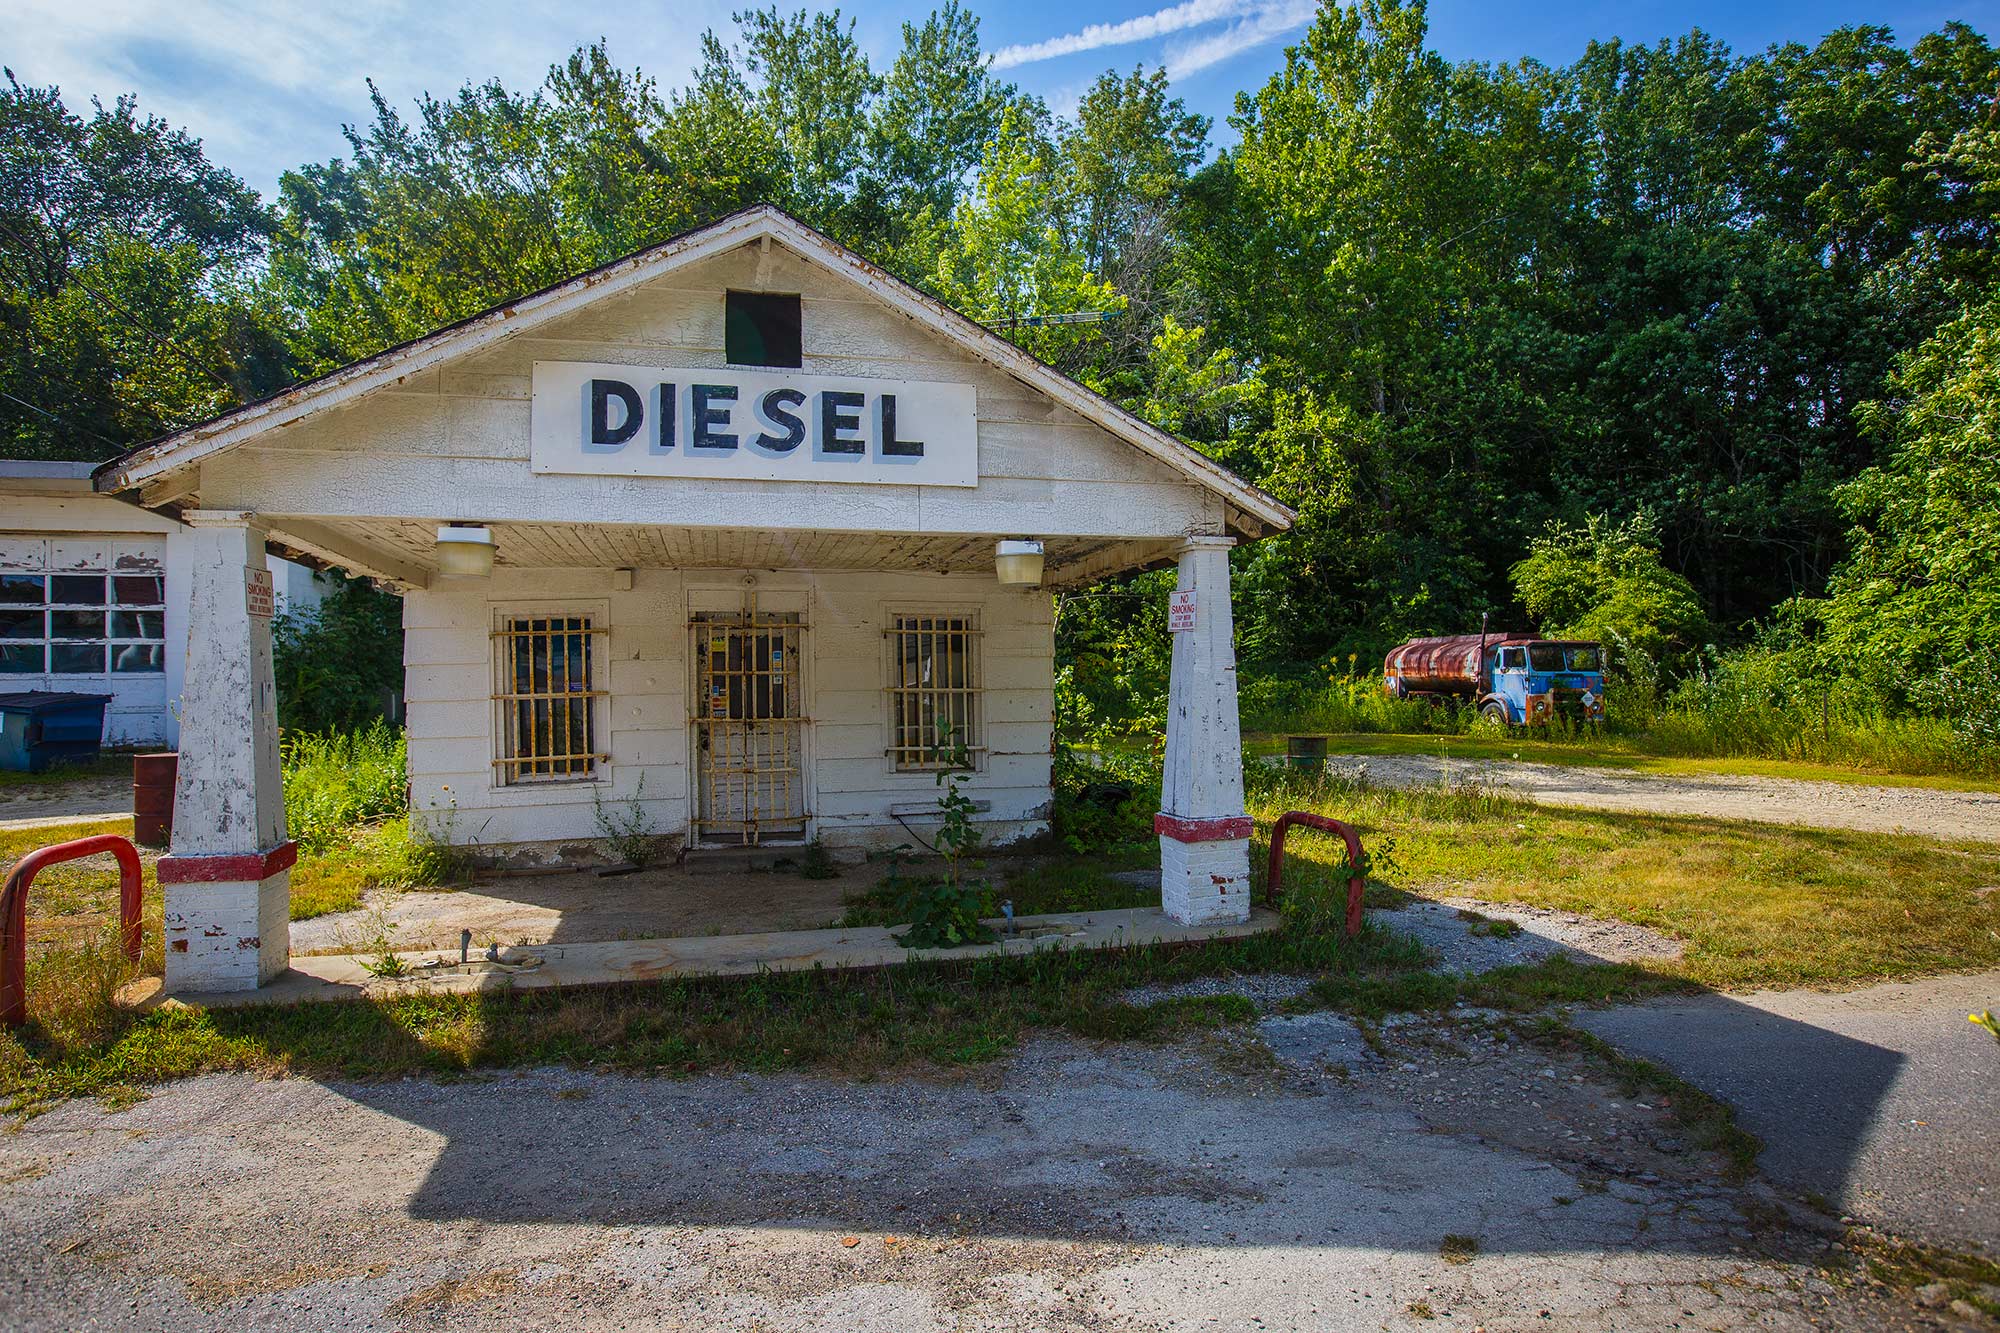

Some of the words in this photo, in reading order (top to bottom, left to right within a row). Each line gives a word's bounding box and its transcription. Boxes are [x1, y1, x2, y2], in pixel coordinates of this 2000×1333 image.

[584, 378, 925, 462] DIESEL
[254, 571, 263, 583] NO
[248, 583, 271, 598] SMOKING
[1180, 594, 1189, 603] NO
[1171, 604, 1194, 615] SMOKING
